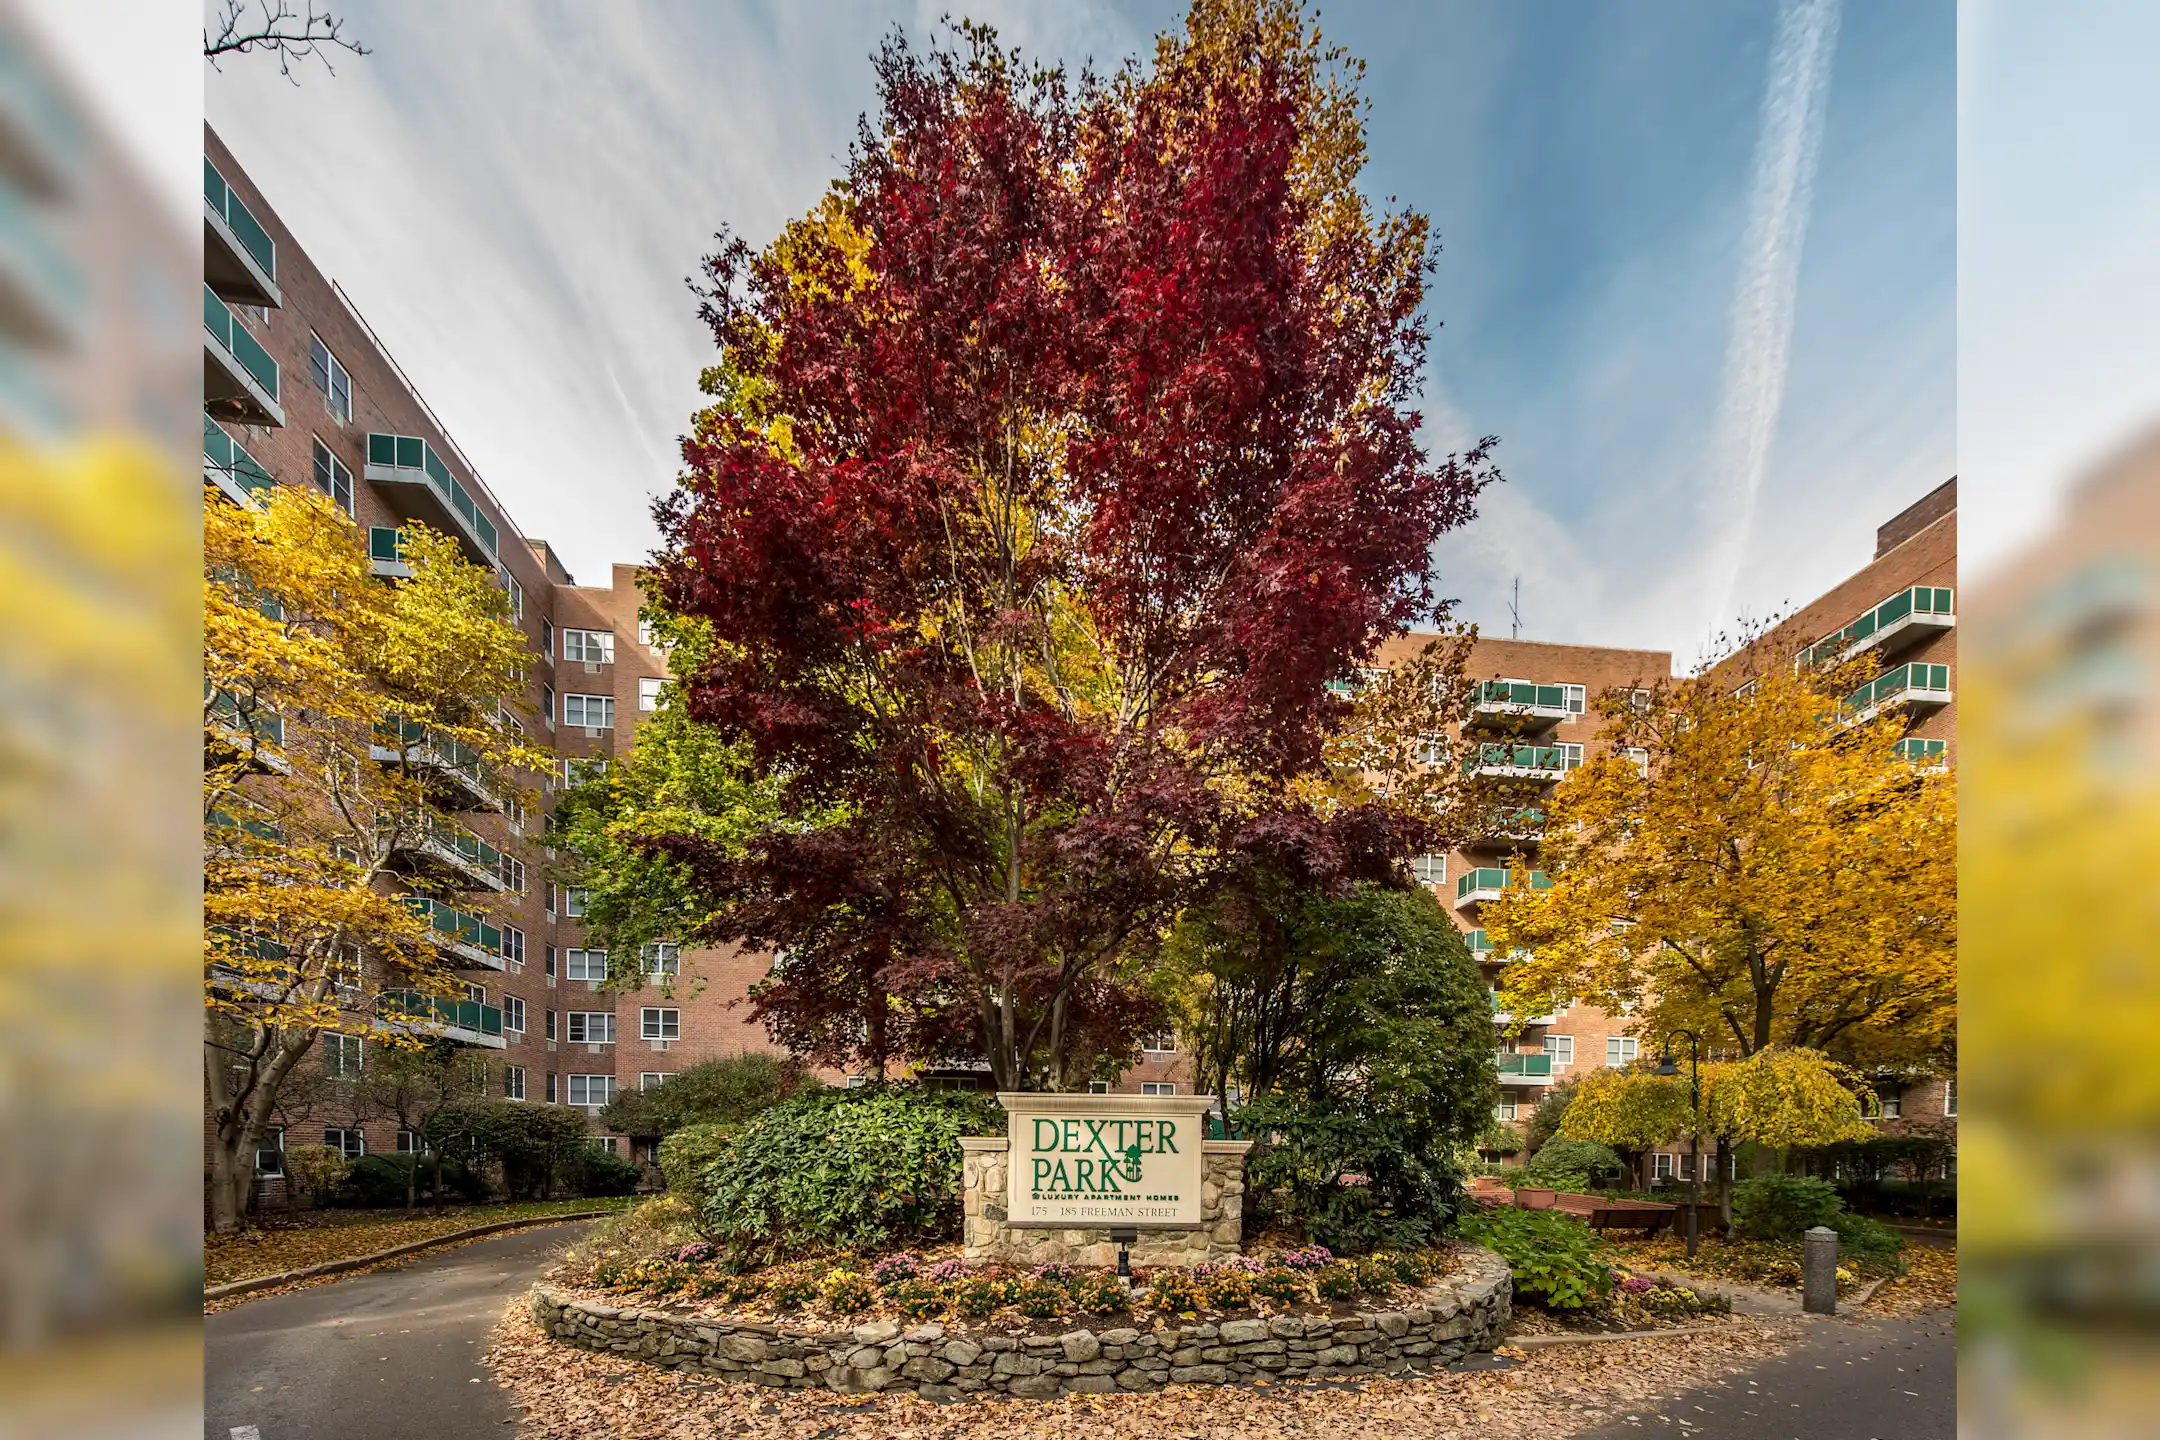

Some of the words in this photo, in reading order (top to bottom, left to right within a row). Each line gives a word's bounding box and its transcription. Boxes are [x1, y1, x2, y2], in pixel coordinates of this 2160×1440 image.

[1032, 1118, 1179, 1153] DEXTER
[1031, 1158, 1121, 1192] PARK
[1032, 1206, 1047, 1216] 175
[1060, 1207, 1077, 1217] 185
[1081, 1207, 1134, 1217] FREEMAN
[1137, 1207, 1179, 1217] STREET
